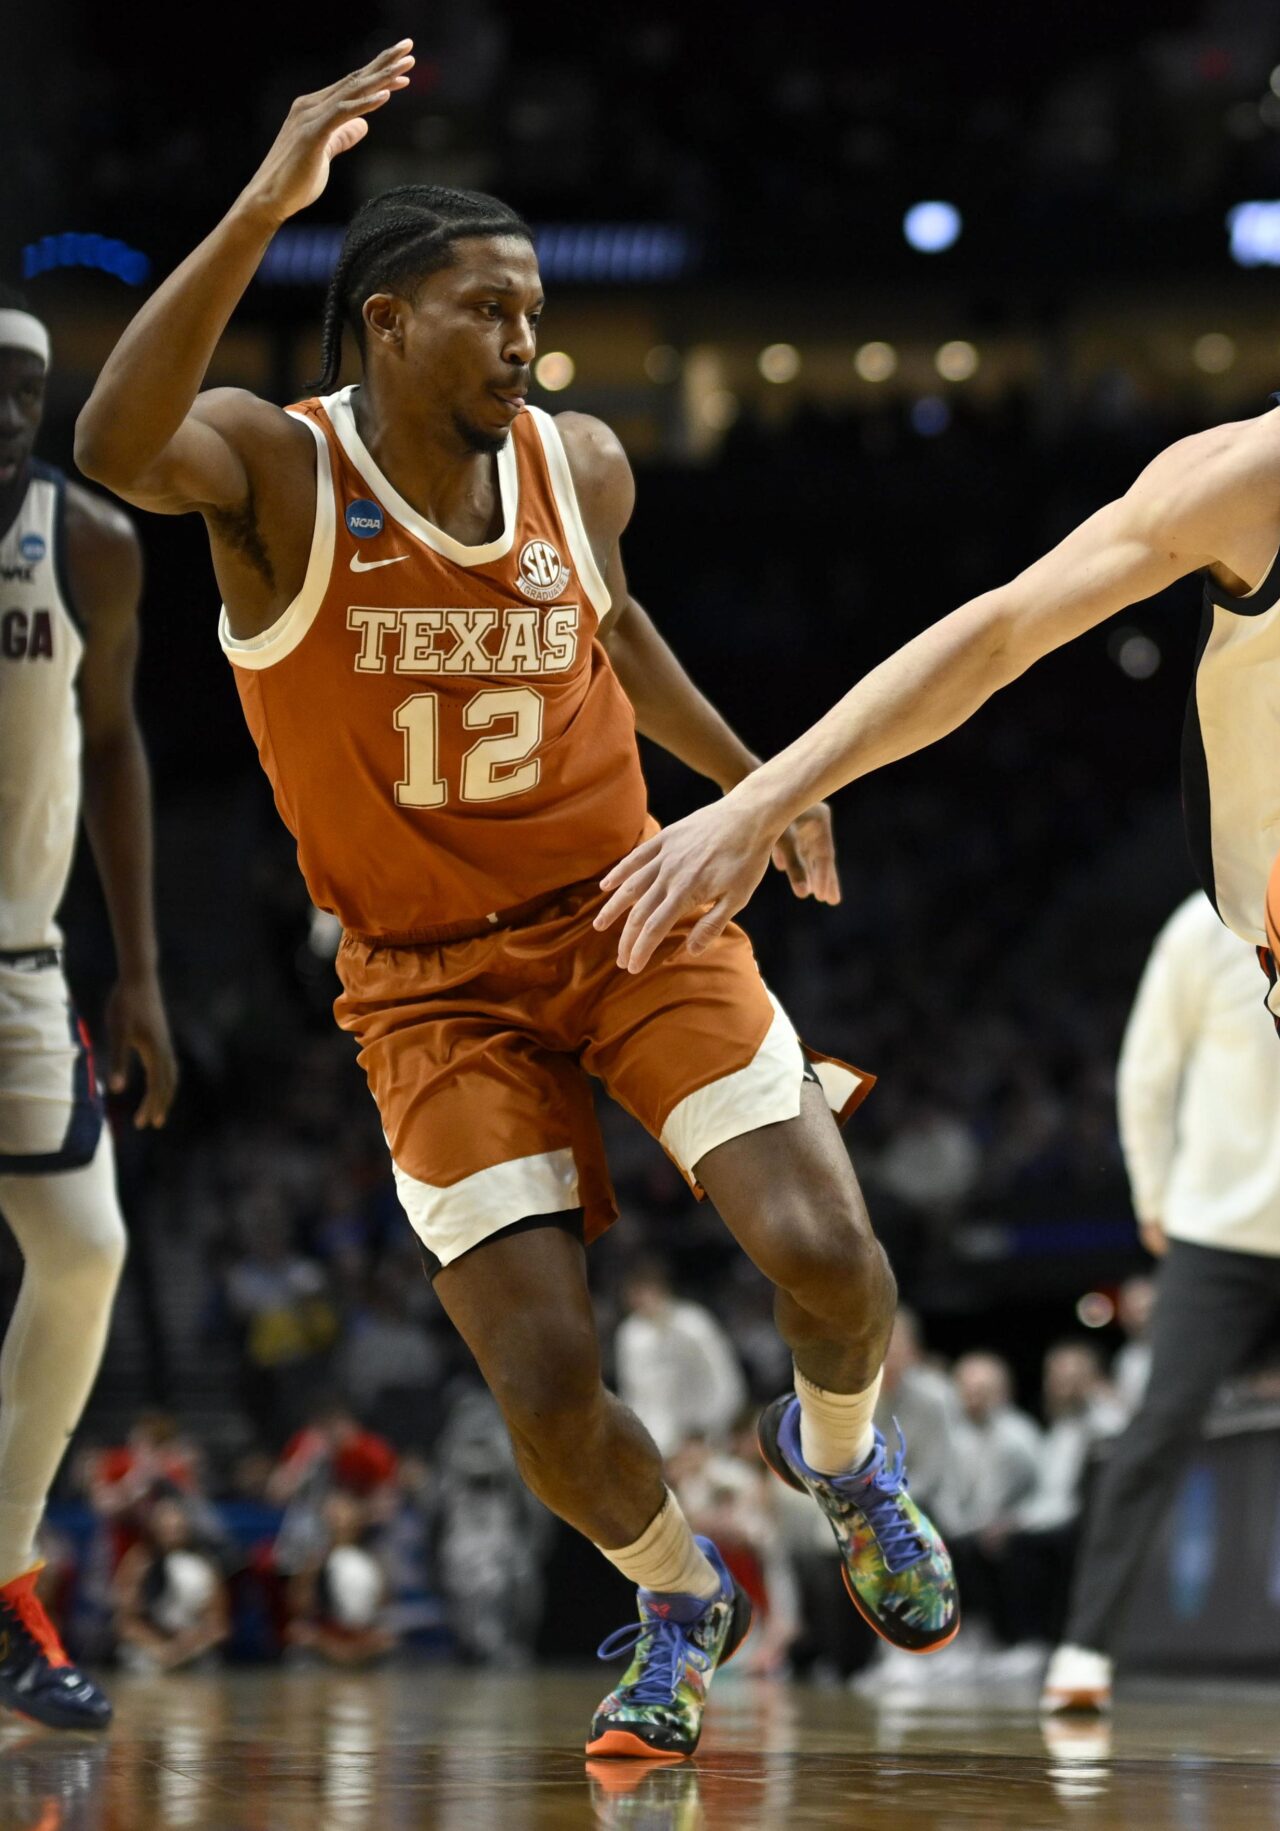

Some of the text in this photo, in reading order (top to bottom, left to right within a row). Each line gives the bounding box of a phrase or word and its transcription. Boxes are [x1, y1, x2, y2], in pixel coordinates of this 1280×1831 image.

[350, 516, 381, 529] NCAA
[522, 542, 559, 586] SEC
[347, 605, 579, 675] TEXAS
[392, 686, 544, 810] 12
